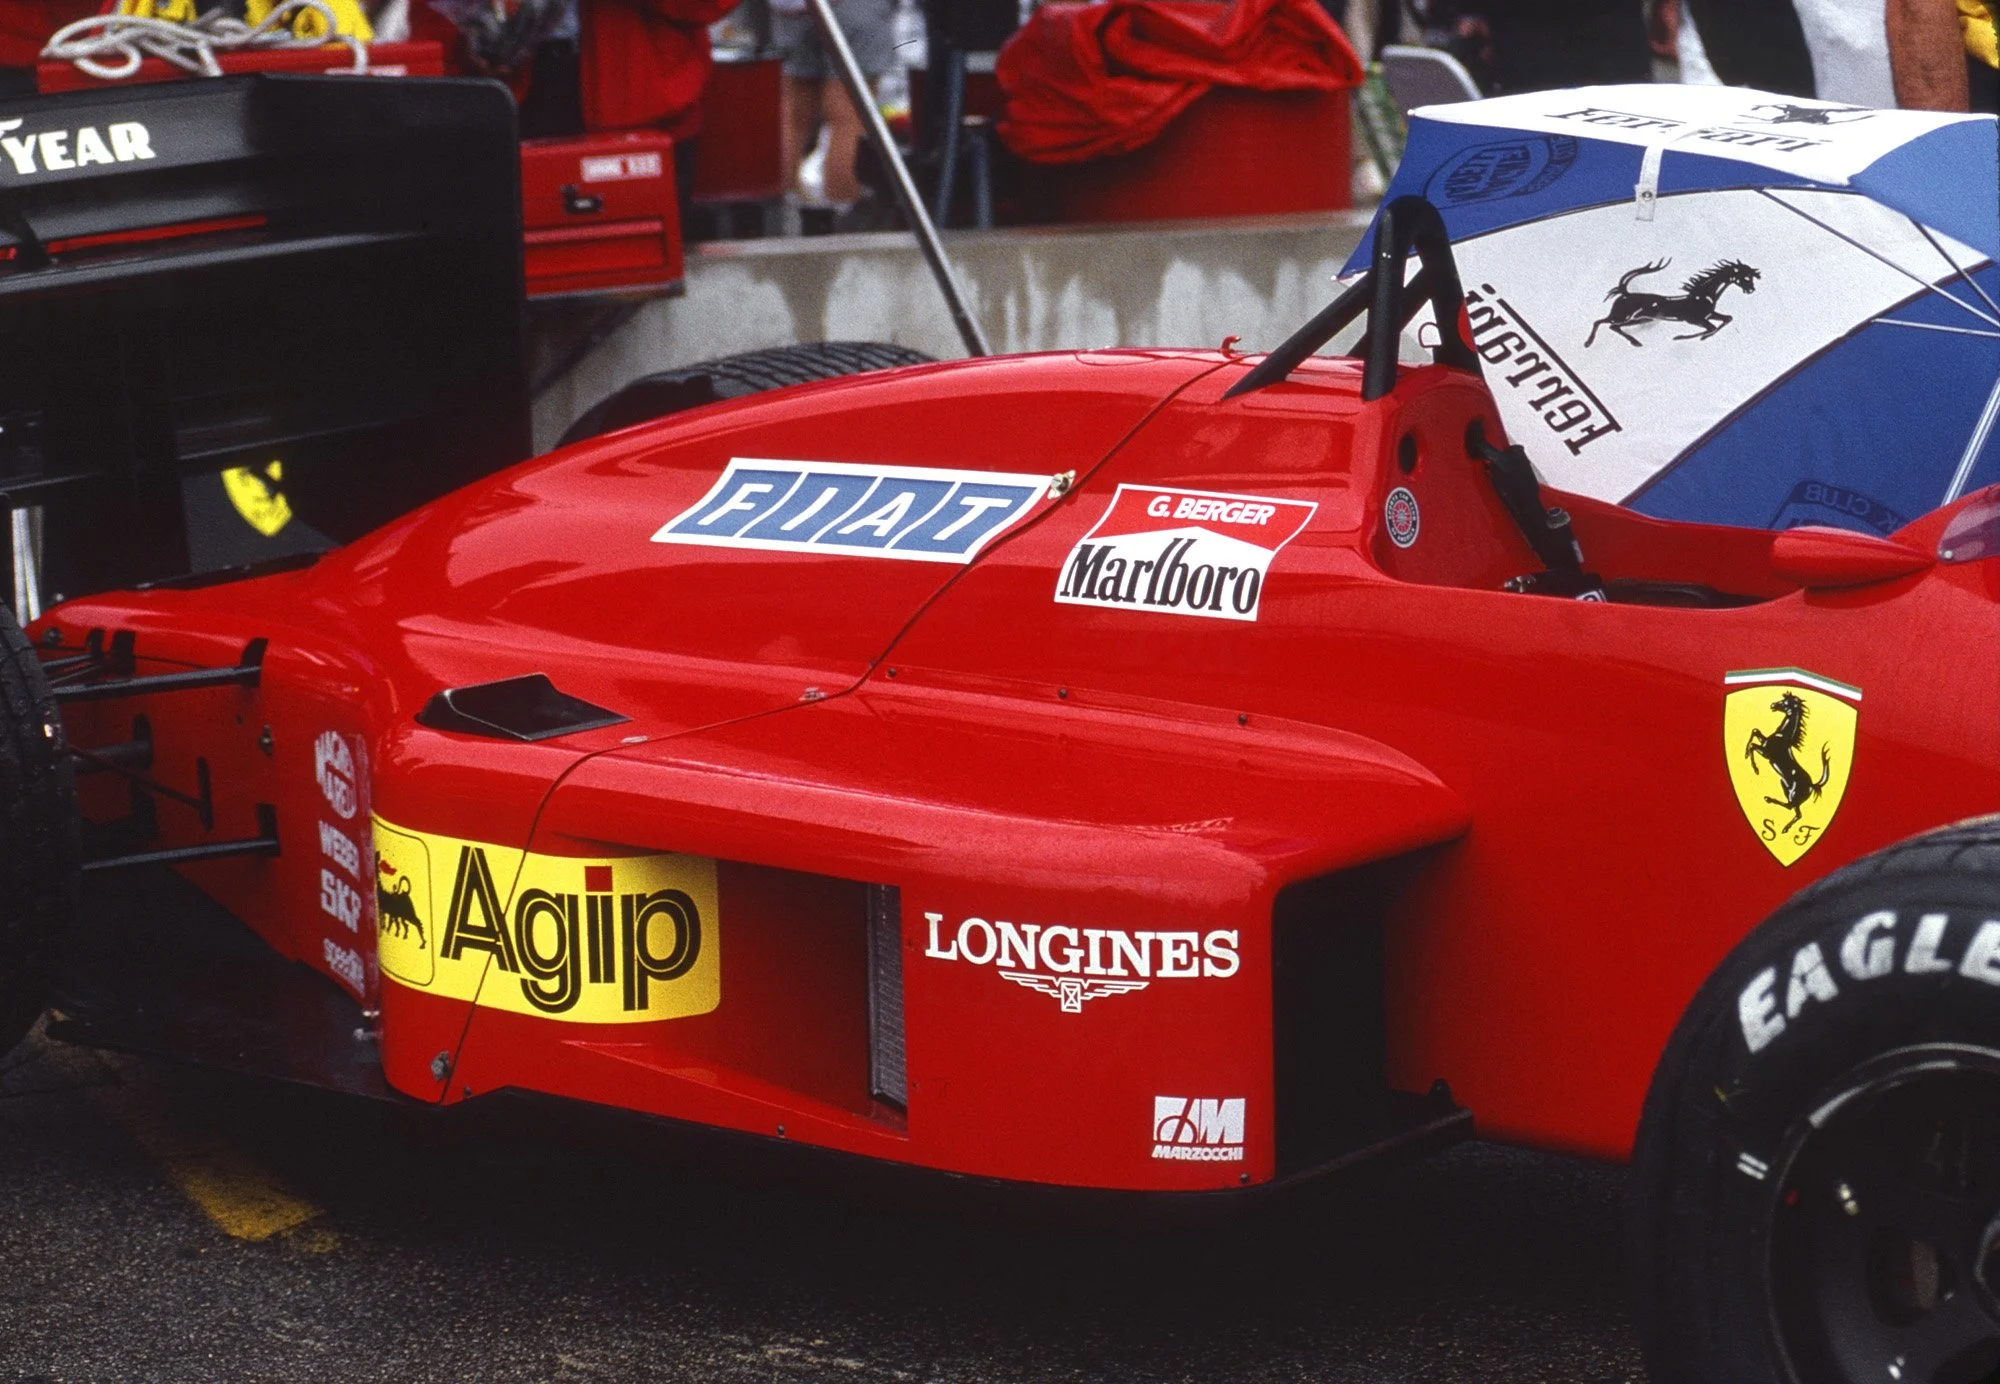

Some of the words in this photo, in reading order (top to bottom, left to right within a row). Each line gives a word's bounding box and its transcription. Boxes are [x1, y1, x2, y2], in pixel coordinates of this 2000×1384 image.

[1, 121, 157, 175] YEAR
[1544, 107, 1834, 153] Ferari
[698, 483, 1013, 541] FIAT
[1147, 495, 1172, 518] G.
[1173, 498, 1276, 526] BERGER
[1059, 537, 1261, 614] Marlboro
[1761, 818, 1777, 841] S
[440, 845, 702, 1014] Agip
[924, 912, 1241, 978] LONGINES
[1738, 910, 2000, 1054] EAGLE
[1151, 1144, 1244, 1161] MARZOCCHI
